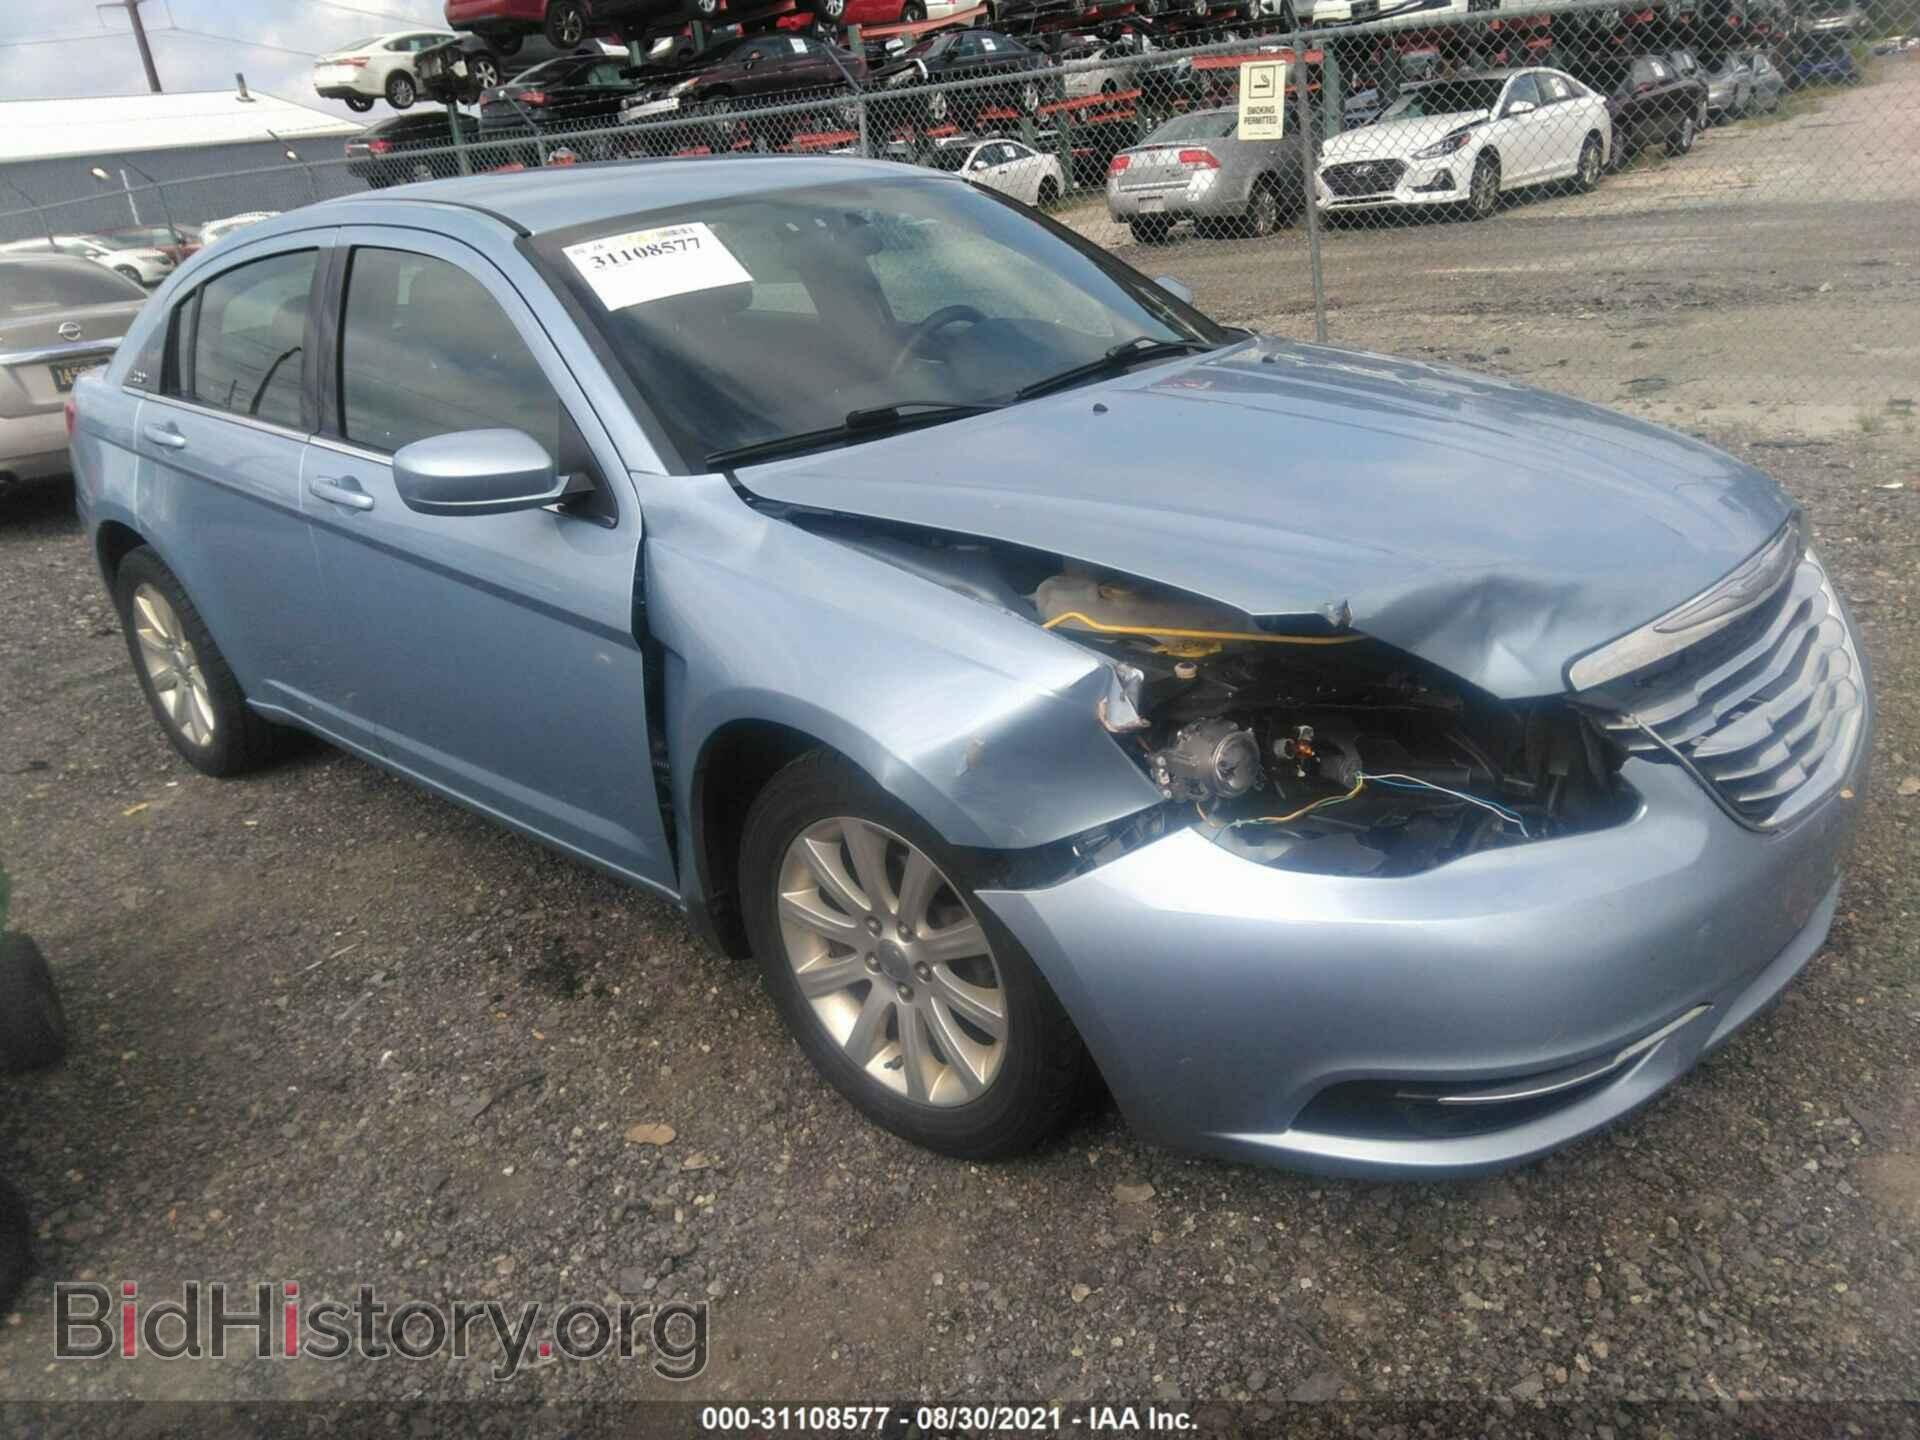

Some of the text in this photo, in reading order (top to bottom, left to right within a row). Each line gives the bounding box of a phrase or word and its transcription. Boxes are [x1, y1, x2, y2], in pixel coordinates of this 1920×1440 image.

[1247, 105, 1275, 115] SMOKING
[1243, 115, 1278, 125] PERMITTED
[591, 237, 700, 269] 31108577
